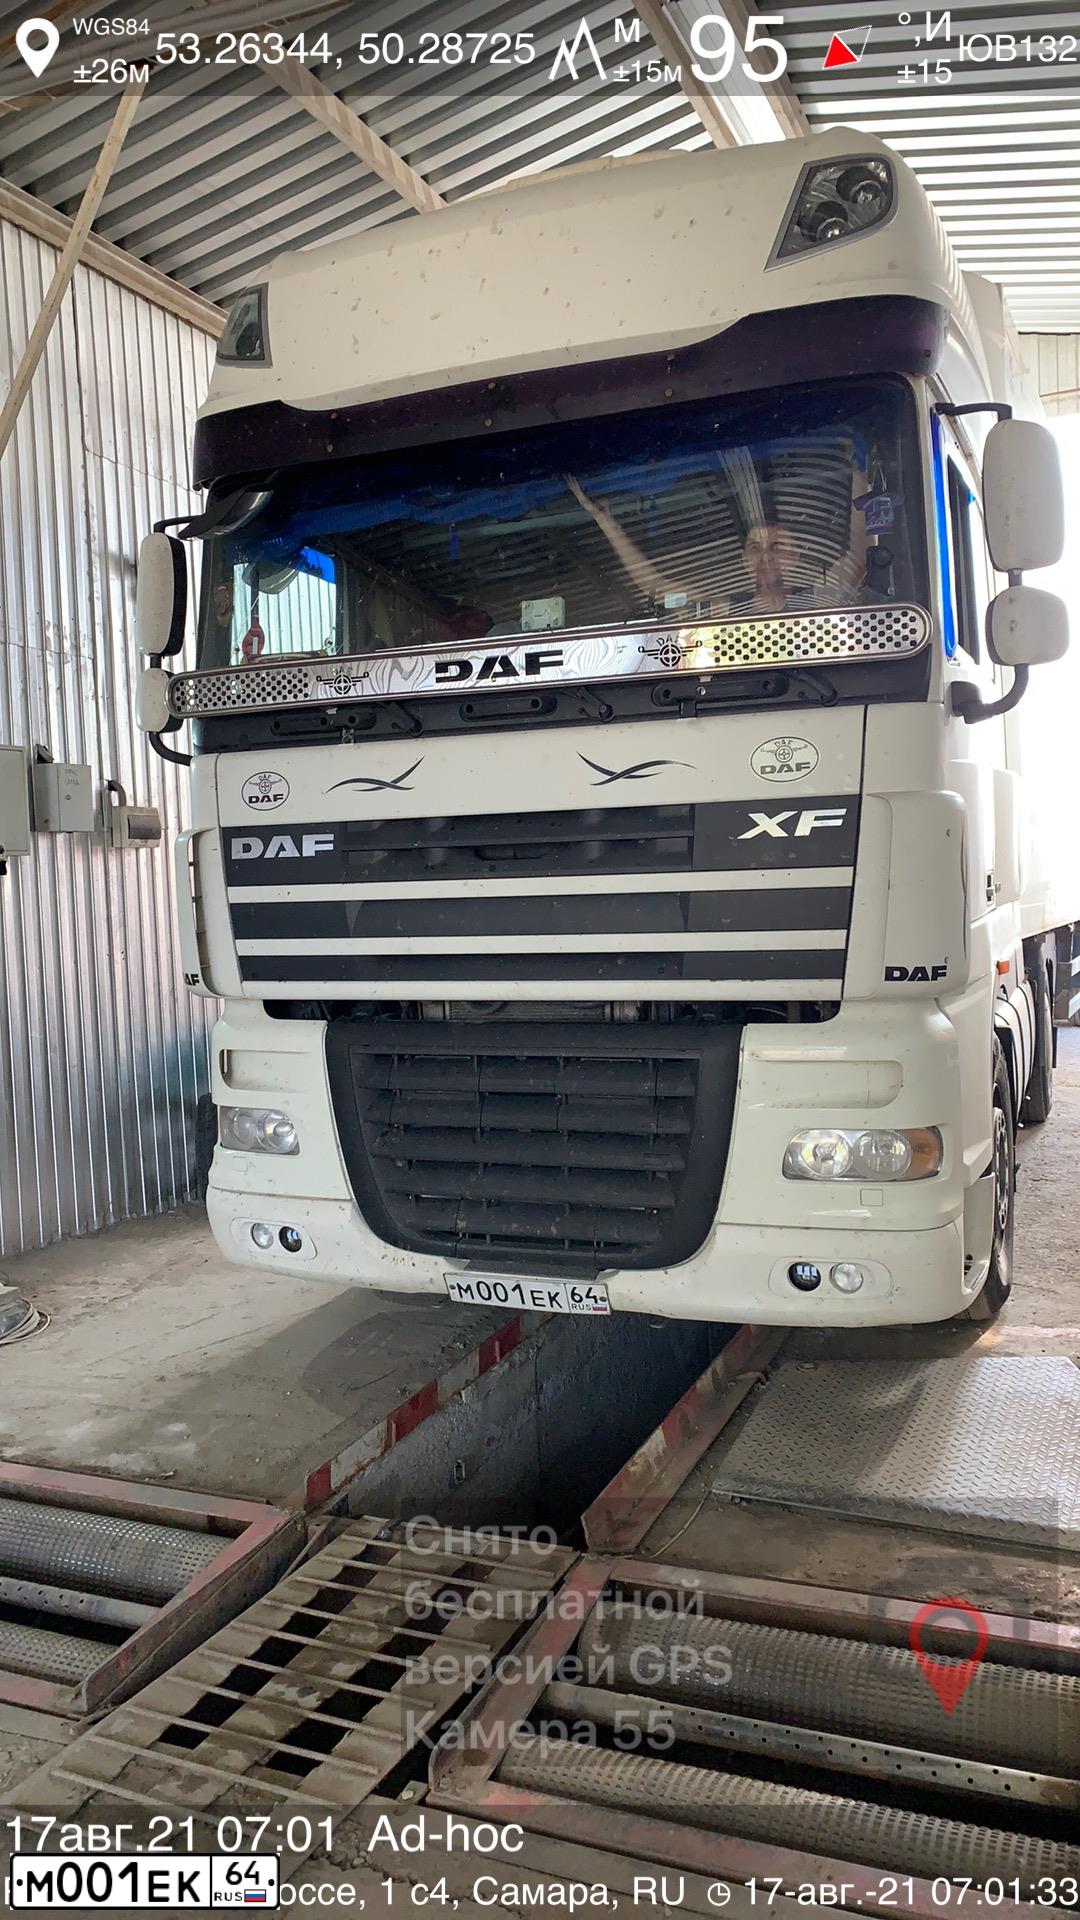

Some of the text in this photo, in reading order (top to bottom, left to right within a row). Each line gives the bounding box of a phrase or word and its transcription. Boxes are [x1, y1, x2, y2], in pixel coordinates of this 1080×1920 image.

[434, 650, 564, 683] DAF
[760, 762, 811, 775] DAF
[248, 794, 284, 804] DAF
[737, 808, 847, 840] XF
[231, 834, 334, 860] DAF
[184, 973, 200, 986] AF
[884, 965, 948, 982] DAF
[571, 1286, 598, 1304] 64
[571, 1303, 592, 1311] RUS
